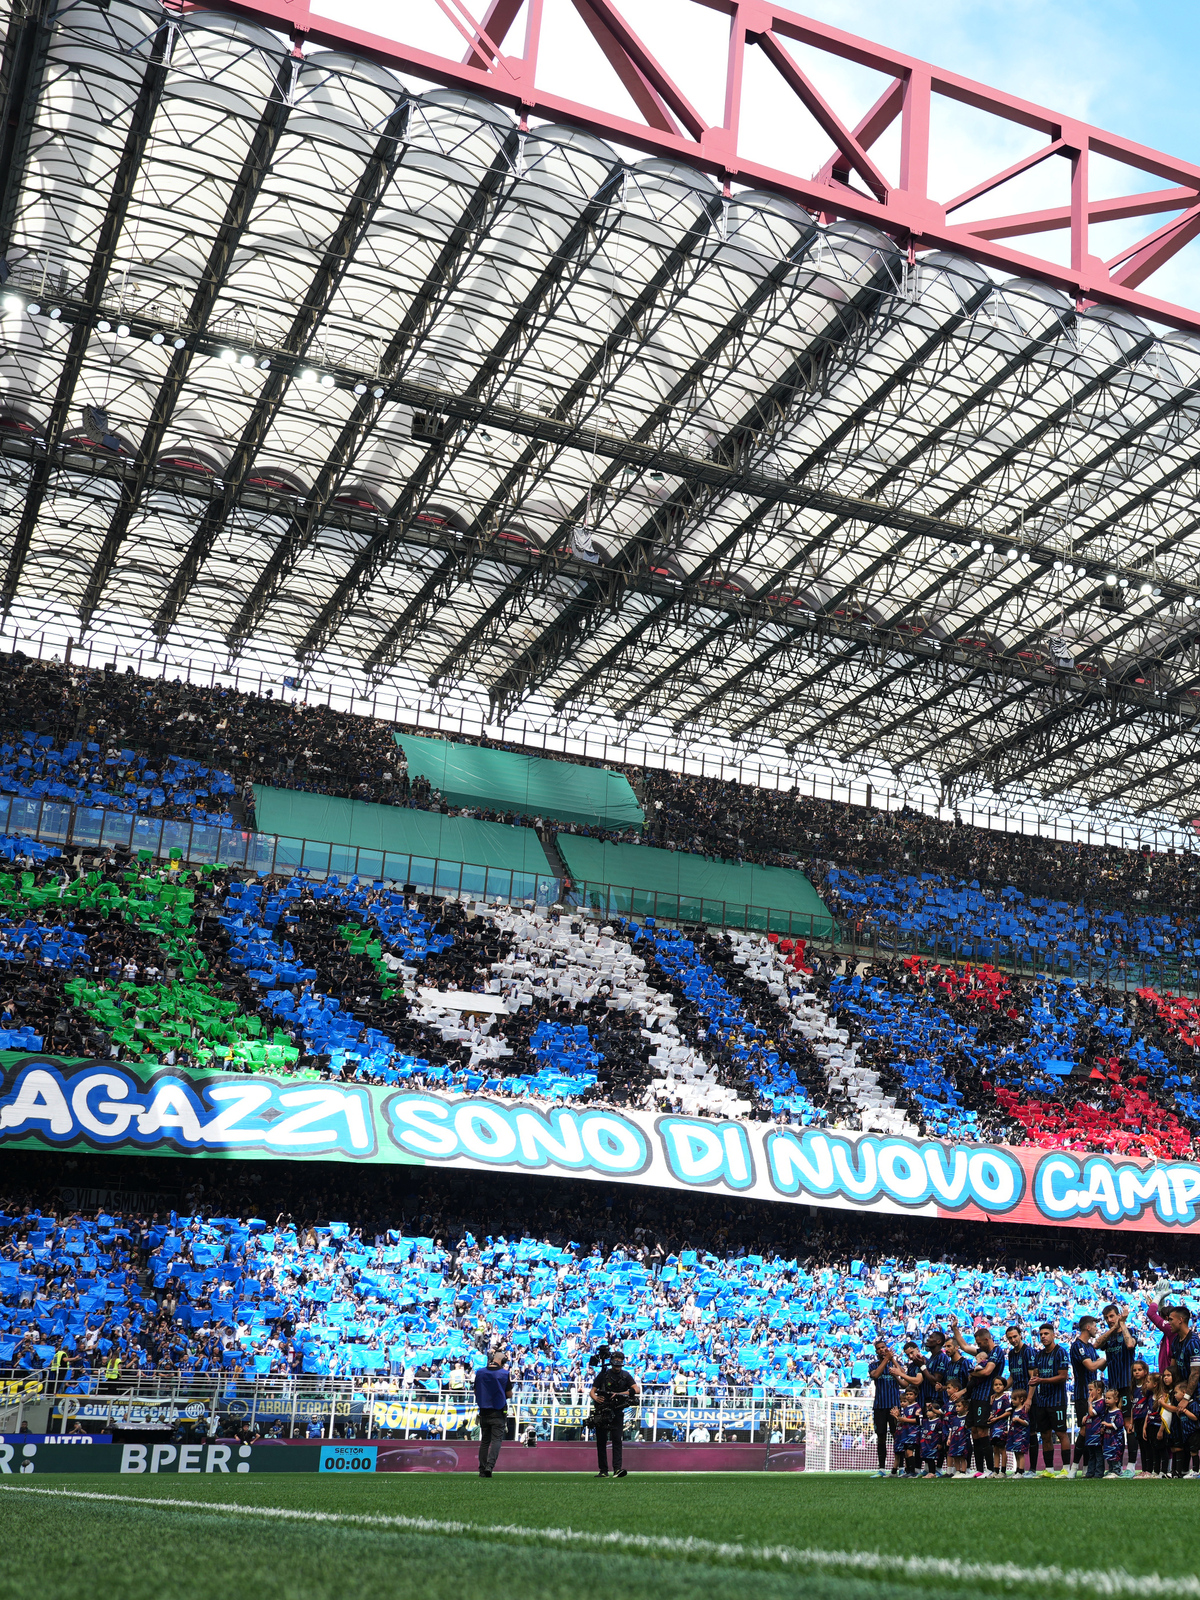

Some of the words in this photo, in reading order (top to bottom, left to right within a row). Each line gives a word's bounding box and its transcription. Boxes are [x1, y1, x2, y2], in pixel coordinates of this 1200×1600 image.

[395, 1099, 641, 1169] SONO
[668, 1123, 749, 1181] DI
[772, 1135, 1014, 1204] NUOVO
[84, 1404, 180, 1417] CIVITAVECCHIA
[258, 1401, 351, 1416] ABBIATEGRASSO
[977, 1406, 982, 1416] 6
[374, 1401, 458, 1430] BORMIO
[1056, 1410, 1063, 1421] 11
[325, 1457, 371, 1470] 00:00
